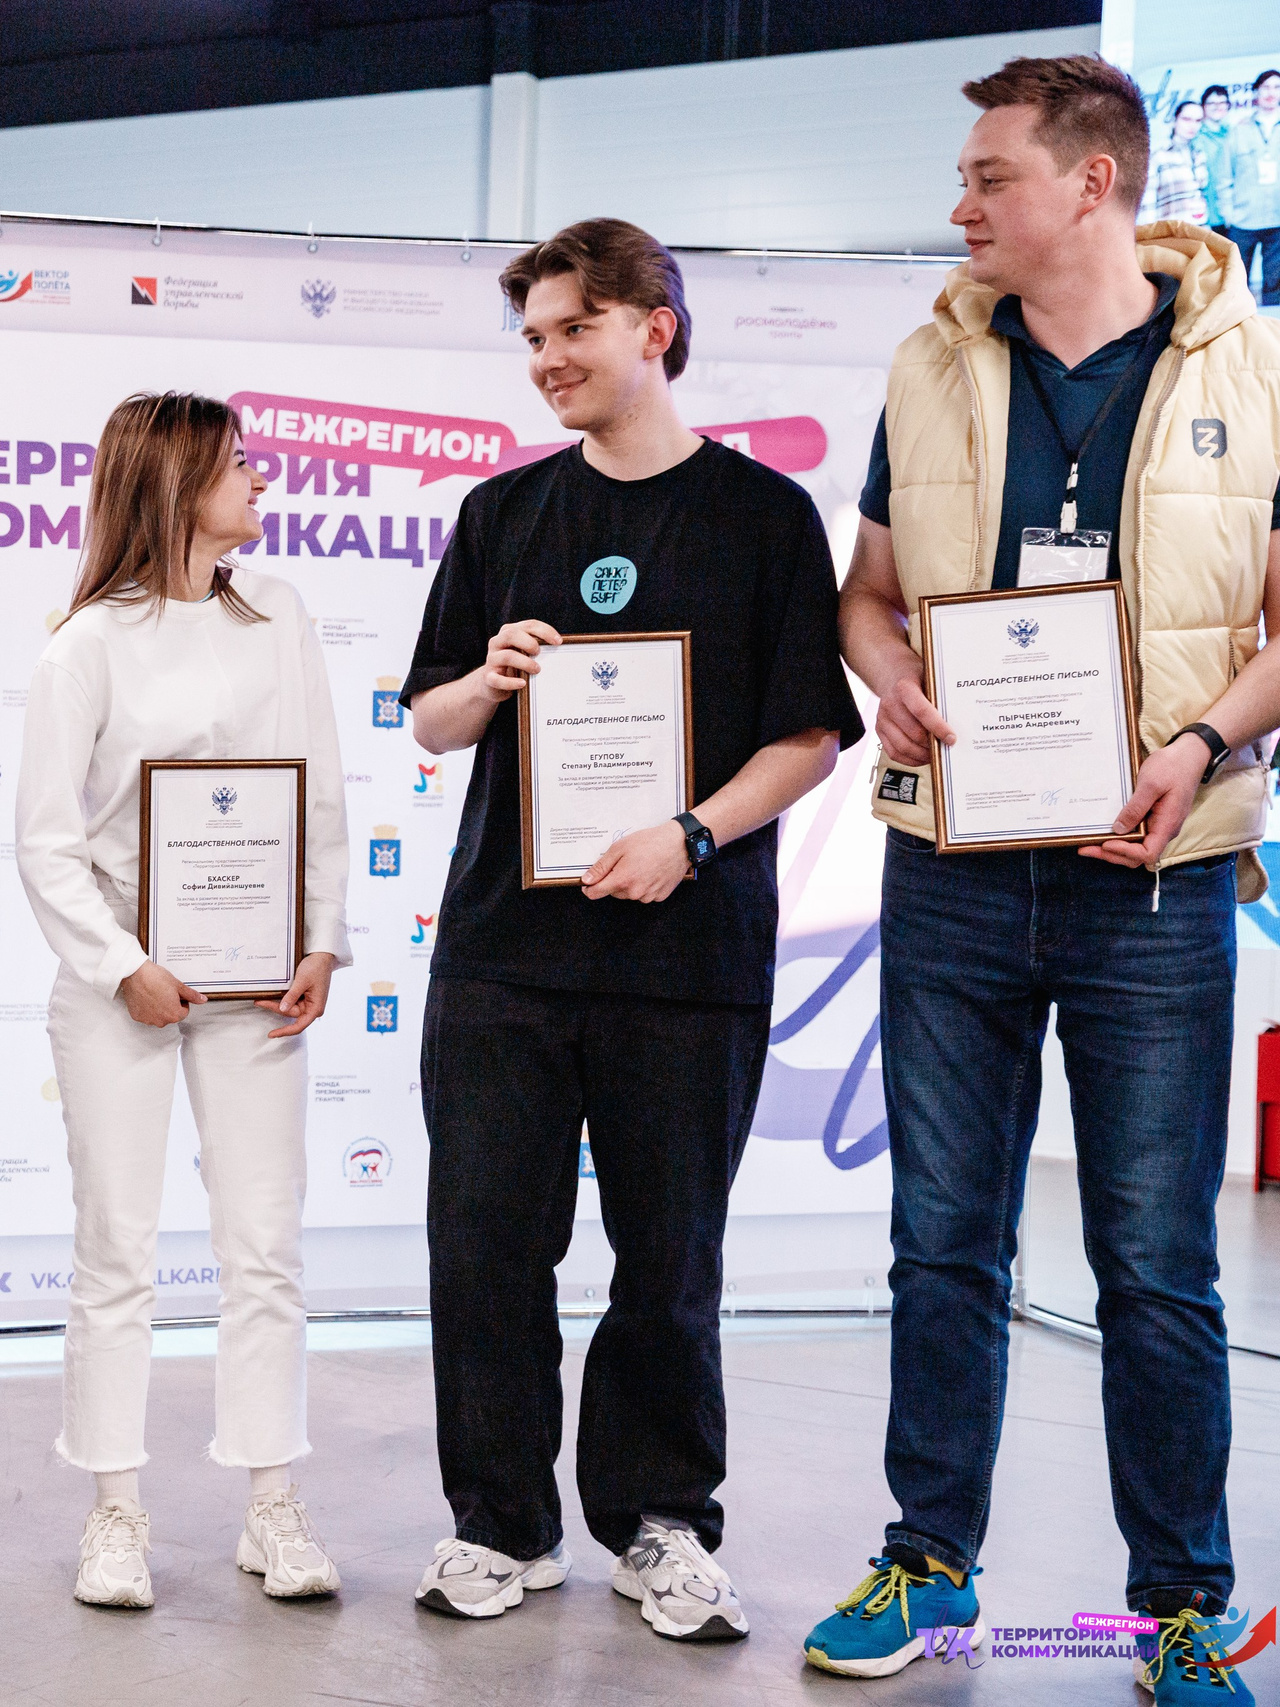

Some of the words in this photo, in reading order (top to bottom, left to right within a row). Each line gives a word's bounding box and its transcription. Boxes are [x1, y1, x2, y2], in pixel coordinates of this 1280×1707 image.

[33, 269, 70, 280] ВЕКТОР
[33, 280, 71, 291] ПОЛЁТА
[241, 405, 502, 464] МЕЖРЕГИОН
[594, 566, 630, 578] САНКТ
[956, 672, 1055, 688] БЛАГОДАРСТВЕННОЕ
[1057, 669, 1100, 679] ПИСЬМО
[546, 716, 630, 726] БЛАГОДАРСТВЕННОЕ
[630, 714, 666, 722] ПИСЬМО
[998, 711, 1063, 722] ПЫРЧЕНКОВУ
[982, 723, 1023, 731] Николаю
[1025, 719, 1081, 728] Андреевичу
[589, 753, 625, 761] ЕГУПОВУ
[593, 760, 654, 768] Владимировичу
[167, 840, 246, 848] БЛАГОДАРСТВЕННОЕ
